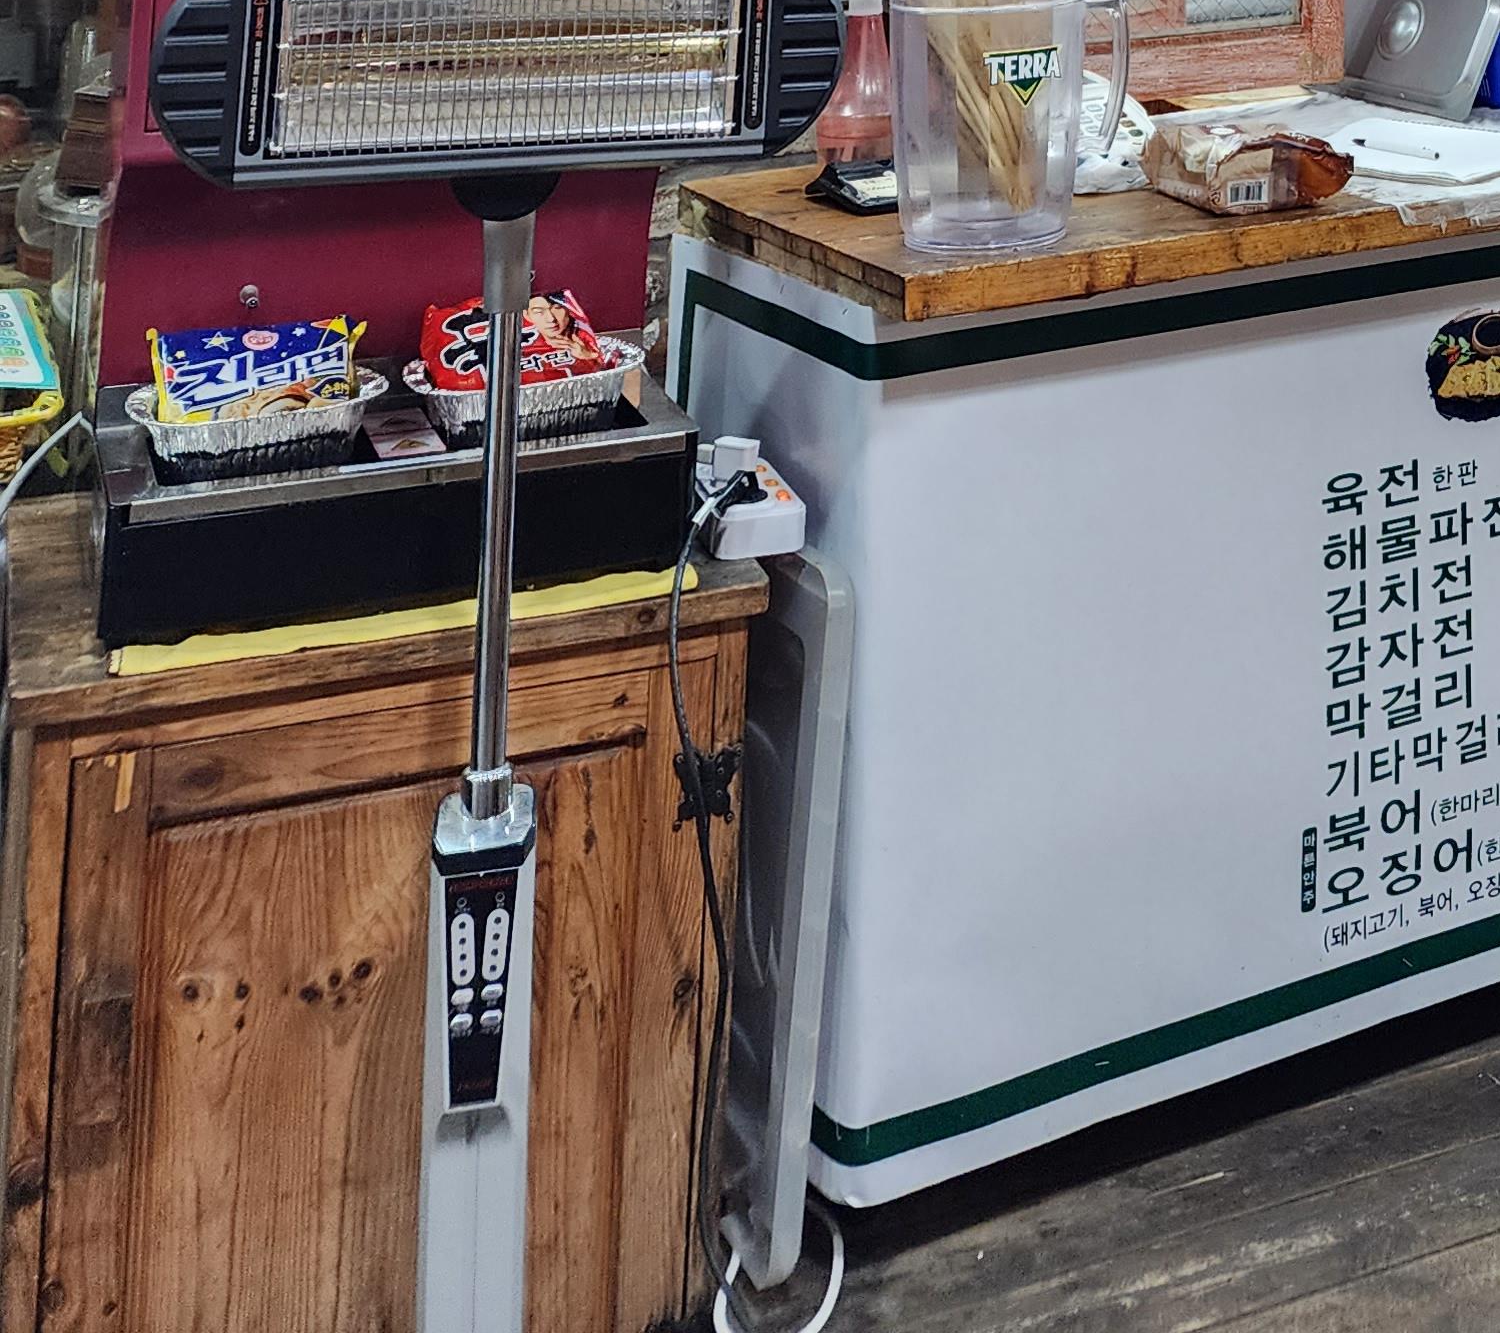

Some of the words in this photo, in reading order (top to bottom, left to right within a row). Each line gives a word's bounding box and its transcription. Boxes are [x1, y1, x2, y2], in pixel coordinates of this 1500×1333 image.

[984, 50, 1062, 86] TERRA
[1321, 458, 1422, 516] 육전
[1432, 459, 1478, 492] 한판
[1325, 555, 1473, 632] 김치전
[1325, 608, 1474, 690] 감자전
[1325, 663, 1473, 740] 막걸리
[1323, 790, 1422, 853] 북어
[1321, 827, 1474, 914] 오징어
[1323, 903, 1410, 953] (돼지고기,
[1417, 888, 1459, 917] 북어,
